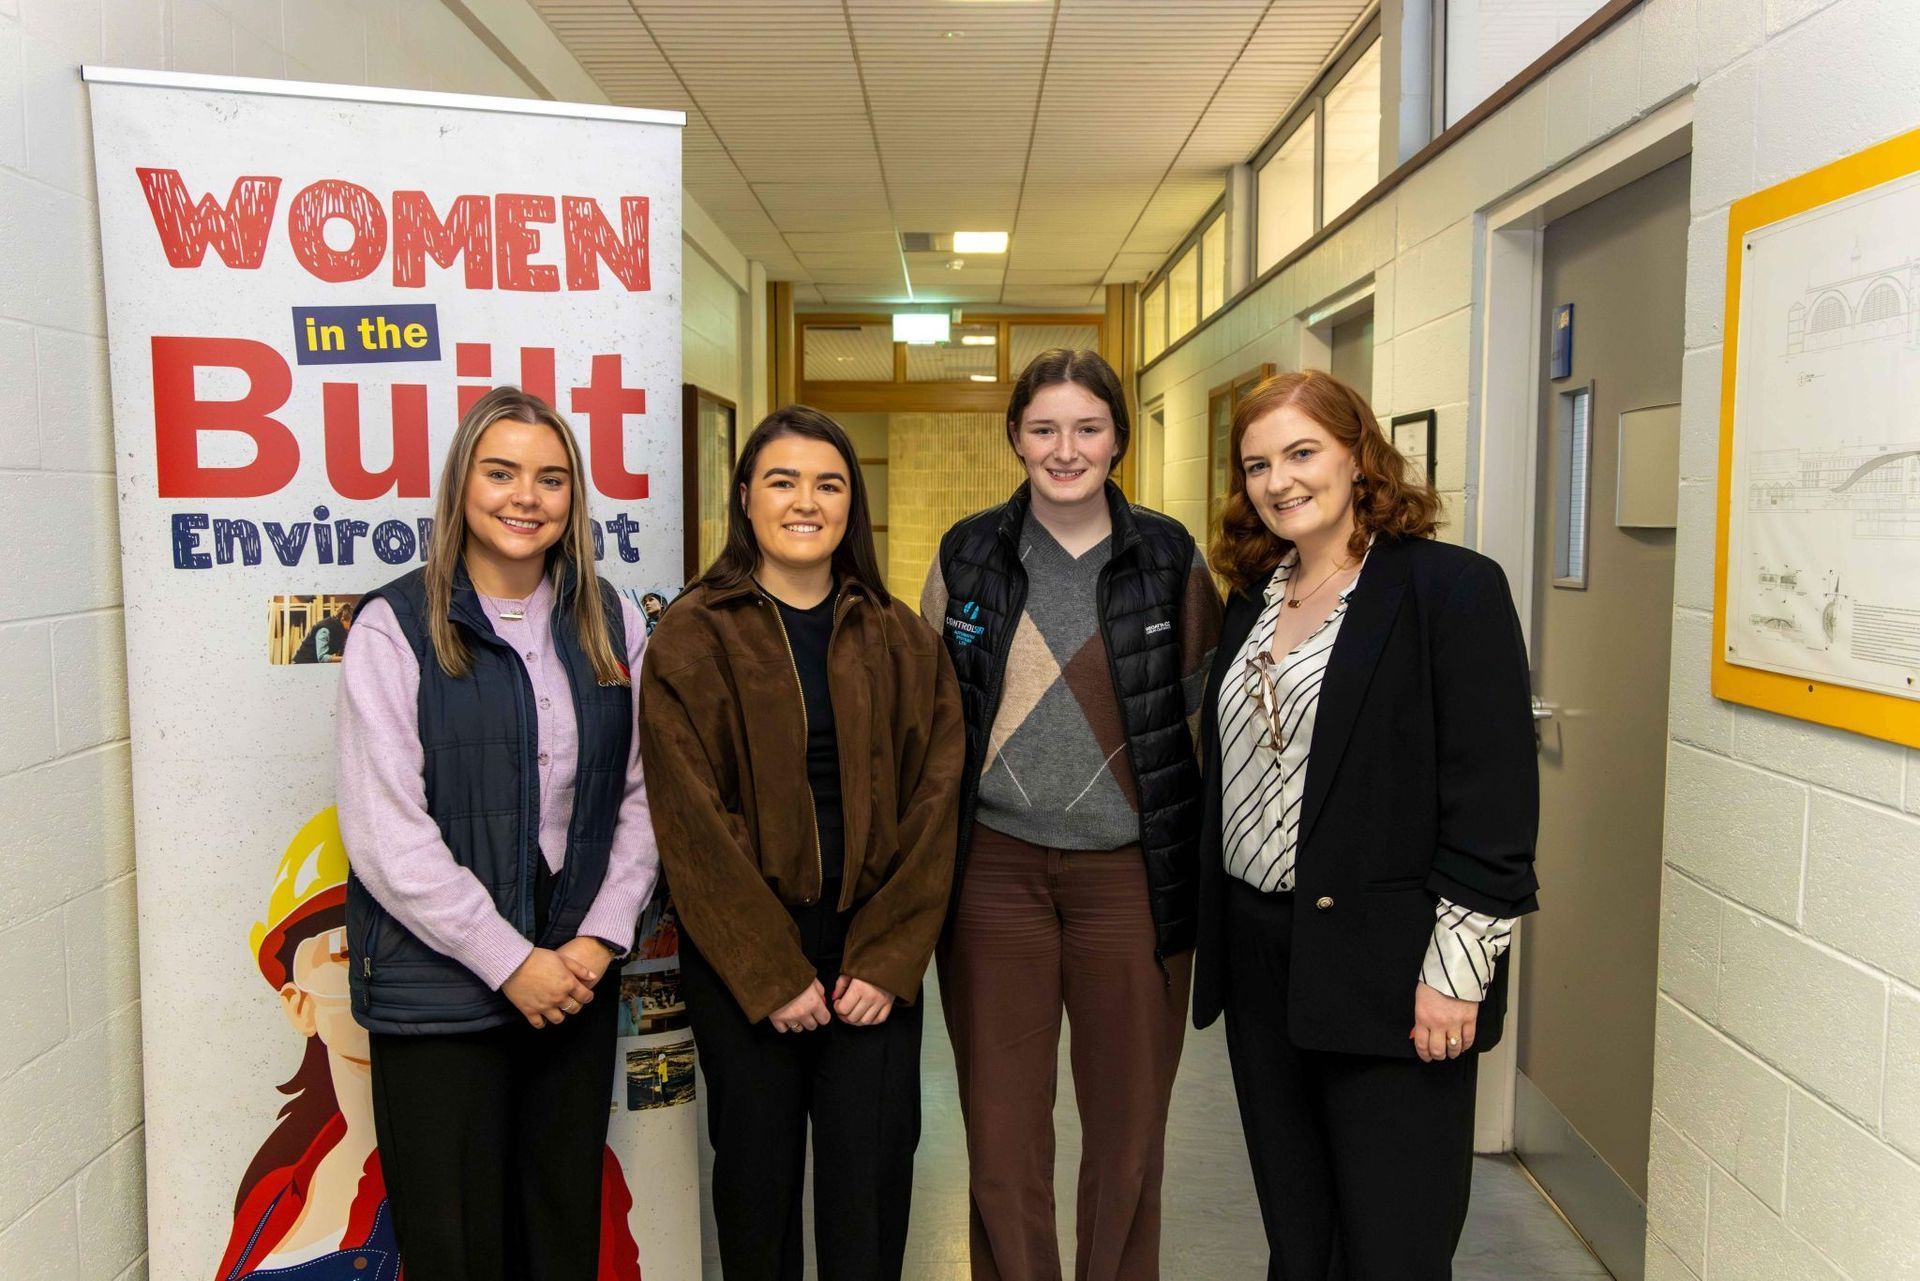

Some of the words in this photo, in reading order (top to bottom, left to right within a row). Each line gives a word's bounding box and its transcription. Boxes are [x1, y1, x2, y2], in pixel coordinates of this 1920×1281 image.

[135, 167, 651, 293] WOMEN
[305, 317, 346, 352] in
[356, 316, 429, 350] the
[171, 504, 640, 571] Envirot
